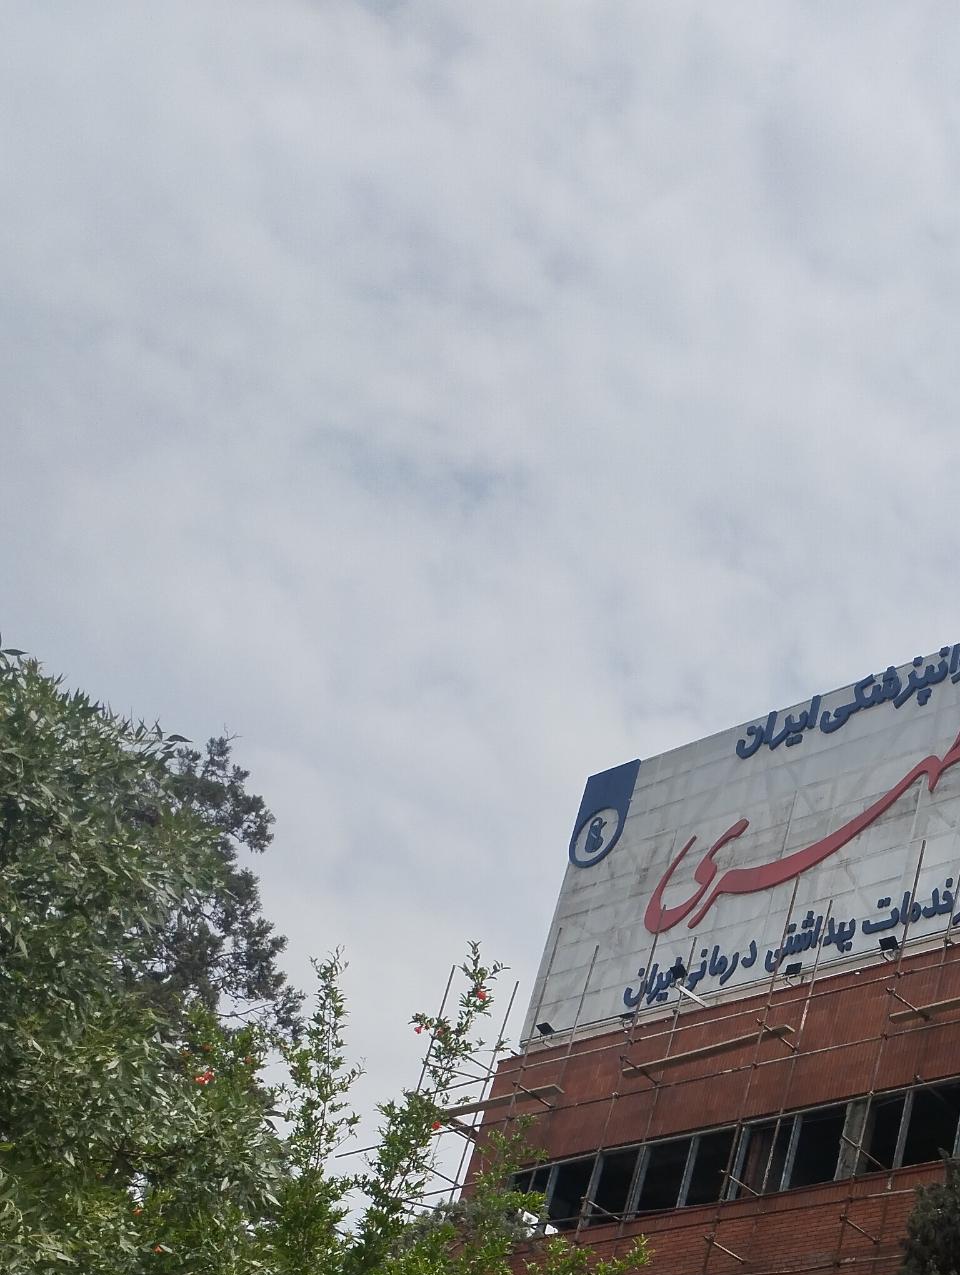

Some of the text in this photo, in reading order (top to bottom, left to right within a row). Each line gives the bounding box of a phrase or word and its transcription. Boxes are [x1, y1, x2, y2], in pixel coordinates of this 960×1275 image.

[735, 695, 822, 760] ایران
[861, 877, 955, 935] خدمات
[765, 910, 856, 973] بهداشتی
